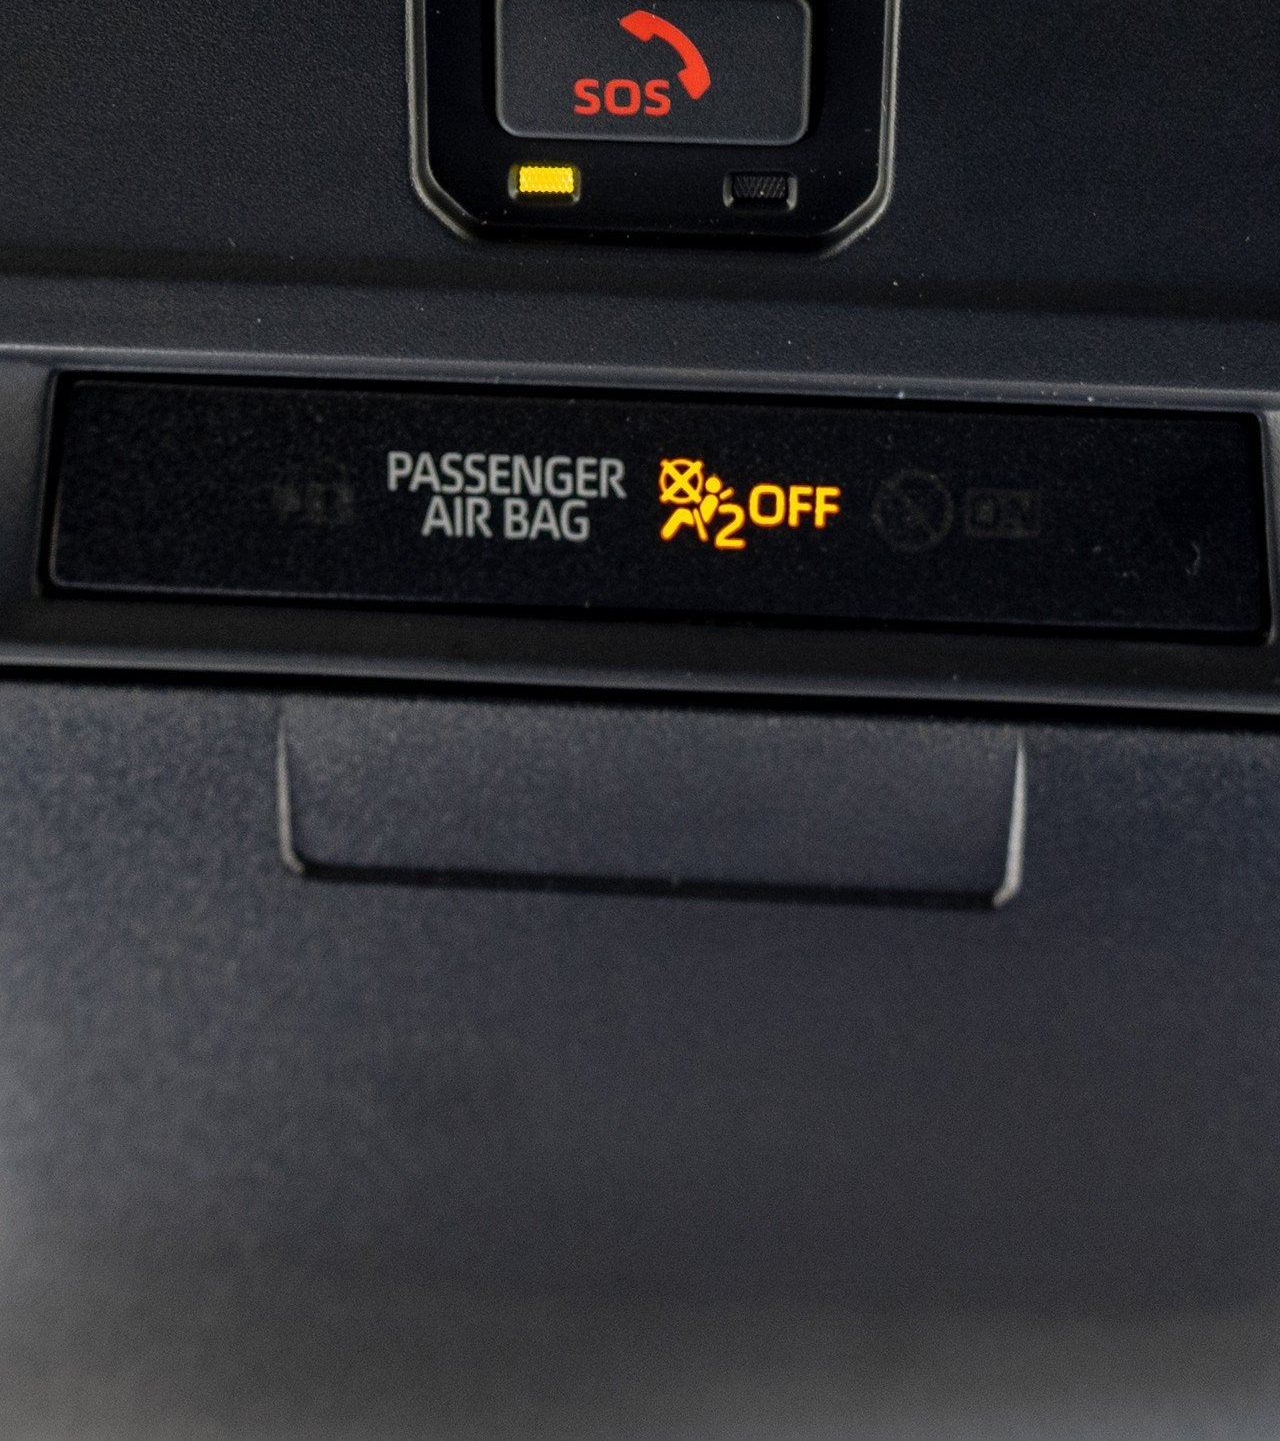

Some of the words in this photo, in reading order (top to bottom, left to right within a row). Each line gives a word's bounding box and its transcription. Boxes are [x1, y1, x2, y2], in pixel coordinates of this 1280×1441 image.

[573, 78, 672, 116] SOS
[387, 451, 627, 500] PASSENGER
[422, 495, 493, 538] AIR
[504, 499, 590, 542] BAG
[749, 483, 841, 528] OFF
